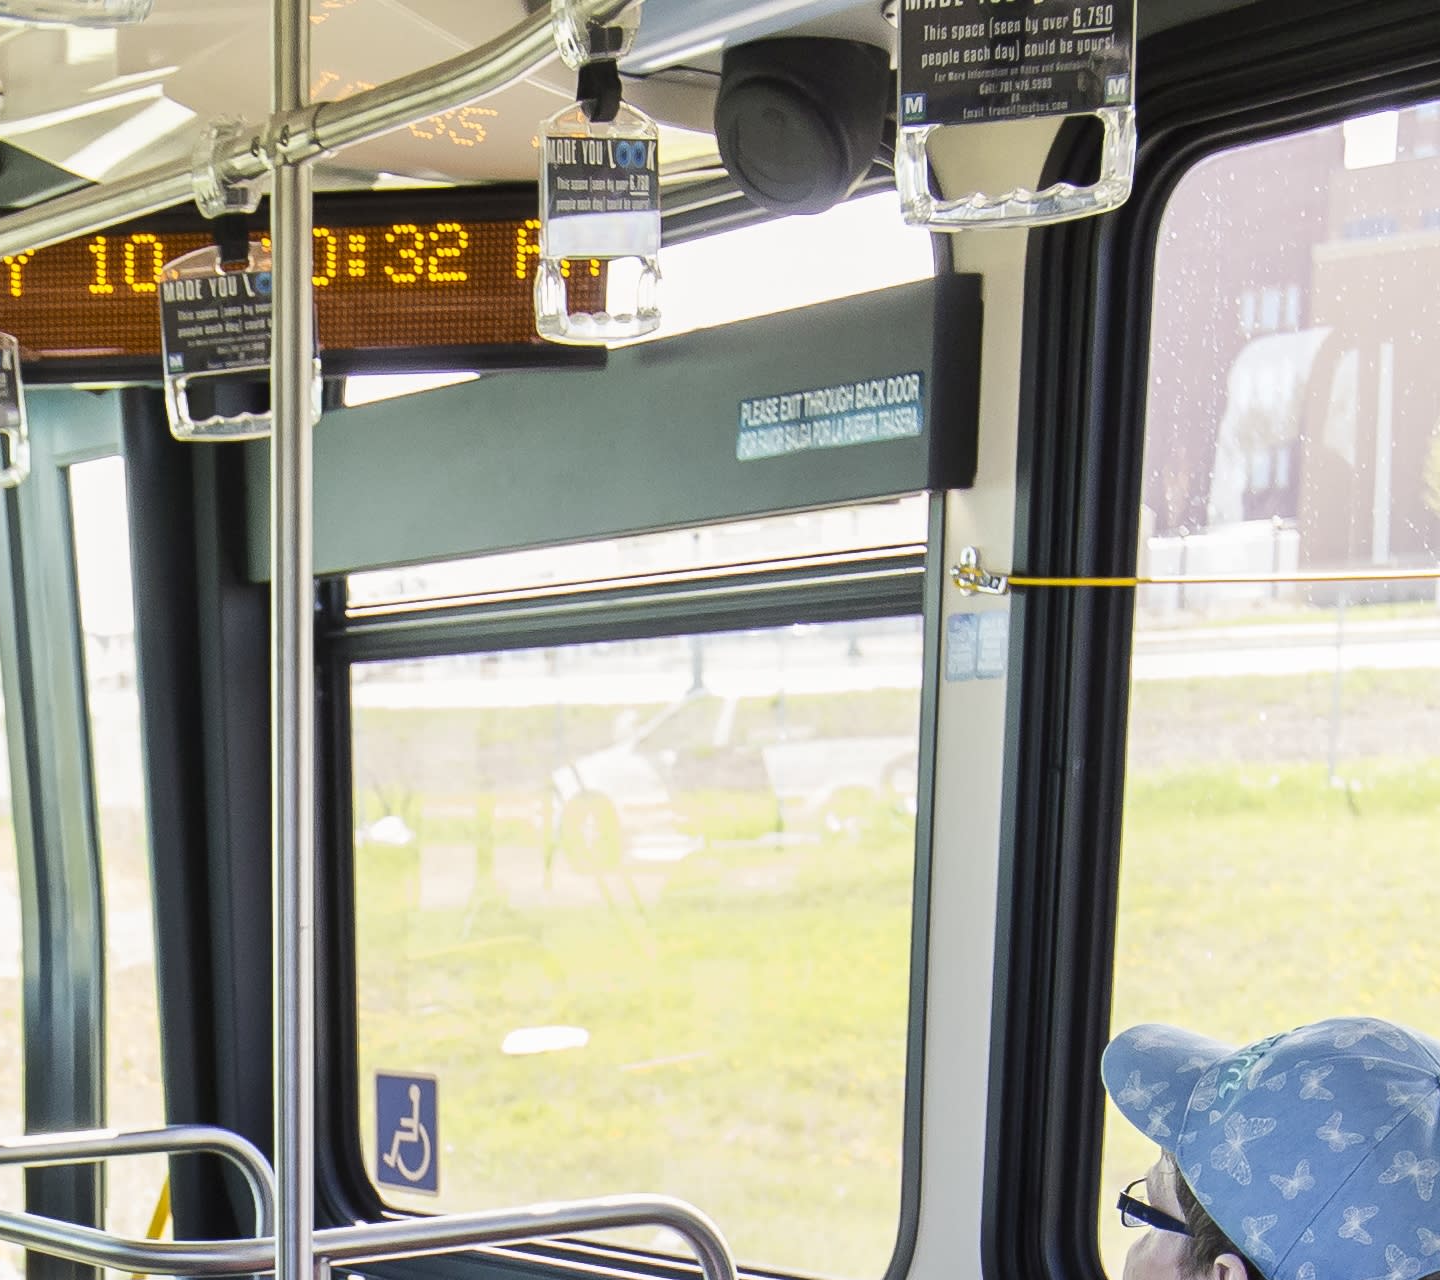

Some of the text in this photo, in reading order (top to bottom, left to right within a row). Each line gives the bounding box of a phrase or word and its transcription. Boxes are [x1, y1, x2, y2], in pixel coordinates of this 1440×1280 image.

[923, 24, 947, 41] This
[951, 22, 985, 40] space
[989, 17, 1020, 38] (seen
[1025, 16, 1038, 34] by
[1042, 15, 1069, 31] over
[921, 33, 1115, 68] people each day) could be yours!
[547, 140, 577, 164] MADE
[582, 139, 603, 165] YOU
[741, 373, 920, 427] PLEASE EXIT THROUGH BACK DOOR
